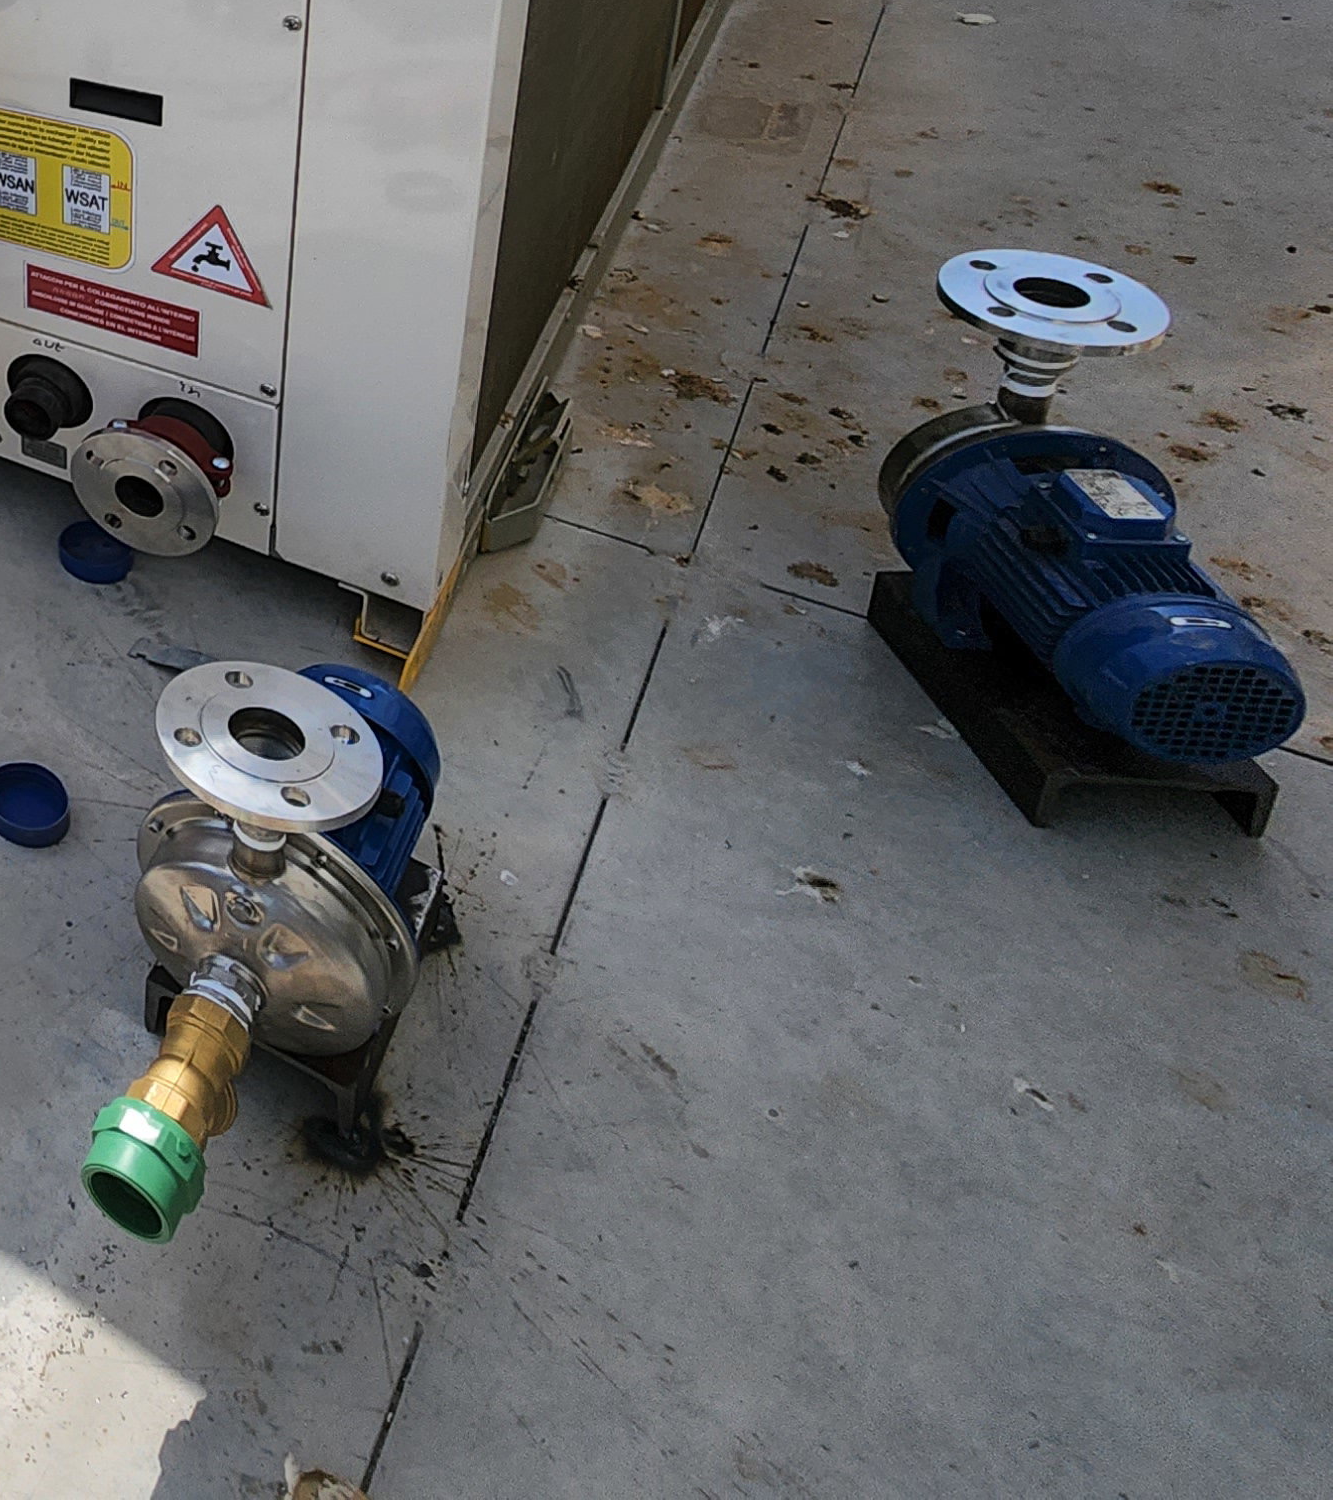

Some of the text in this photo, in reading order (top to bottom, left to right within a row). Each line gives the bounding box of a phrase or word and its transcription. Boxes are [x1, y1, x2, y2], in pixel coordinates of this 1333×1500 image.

[65, 188, 109, 211] WSAT
[64, 279, 78, 290] PER
[87, 286, 147, 309] COLLEGAMENTO
